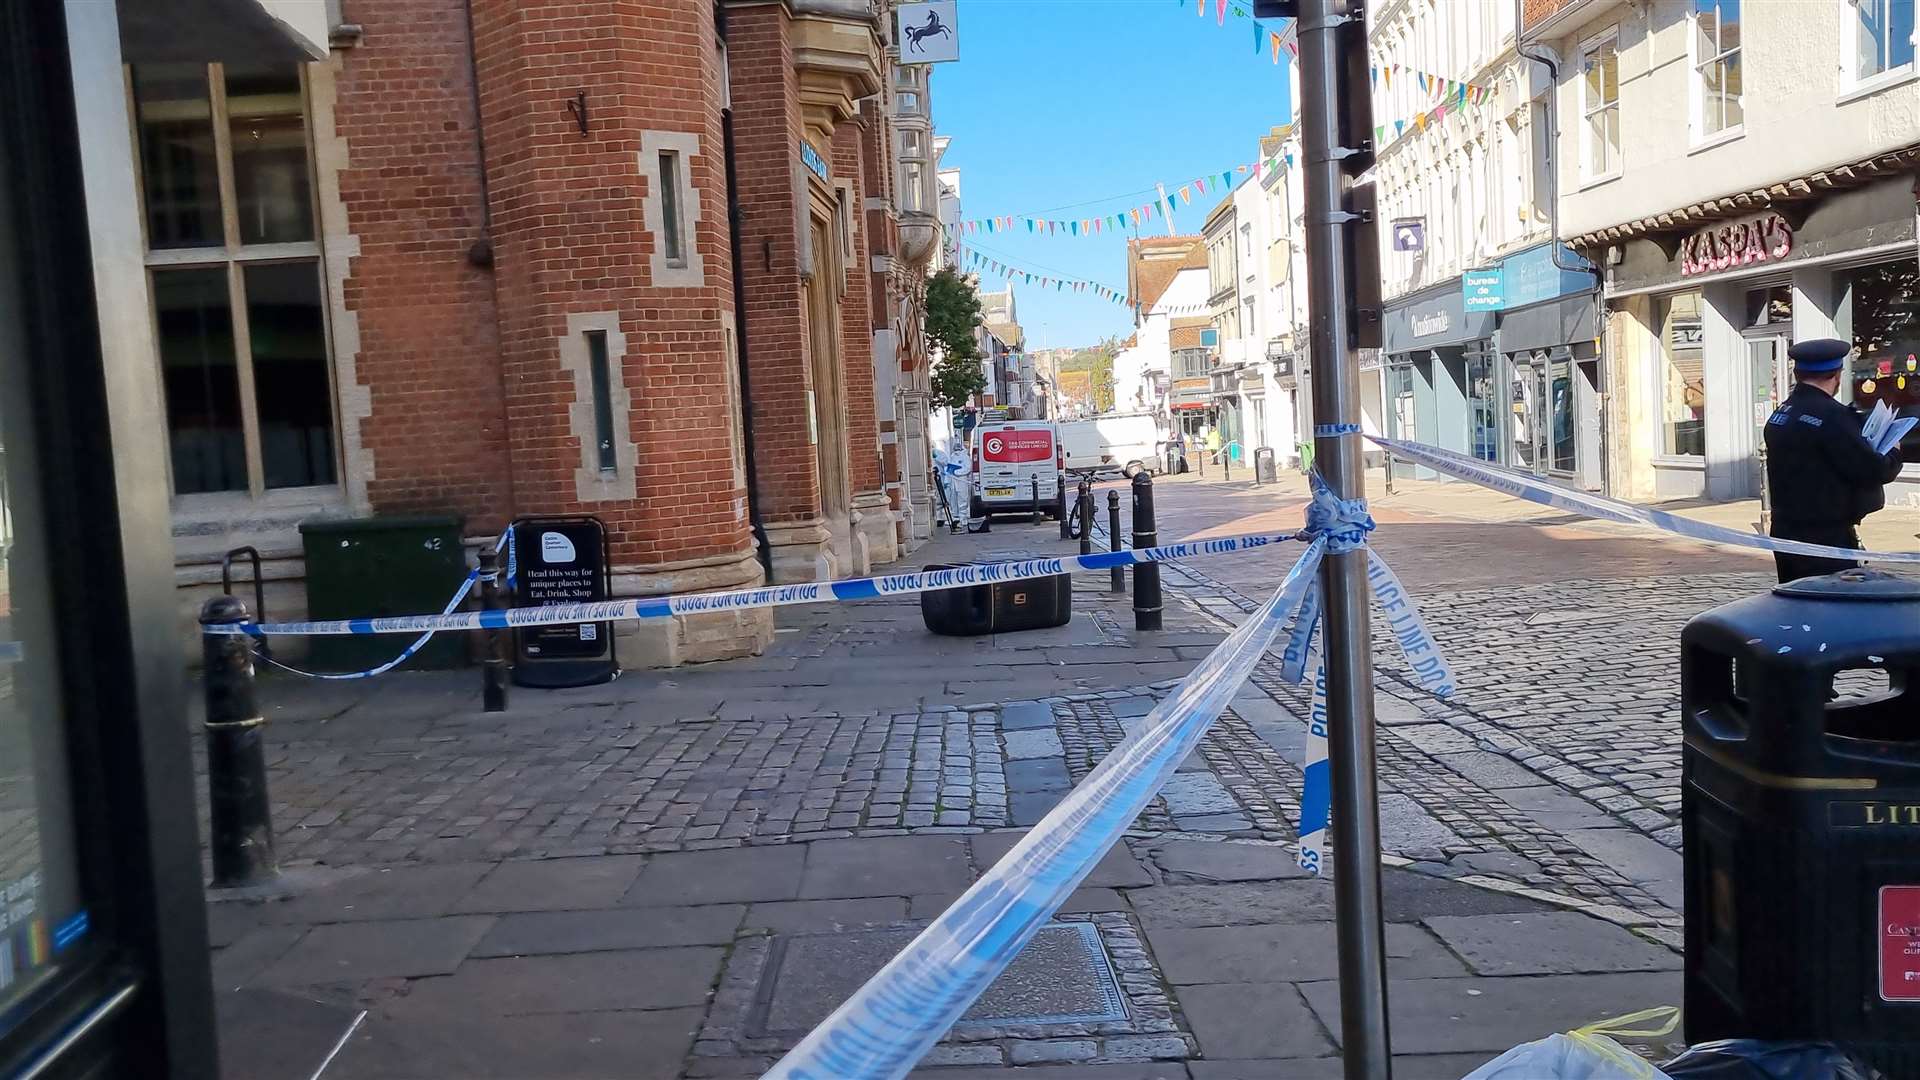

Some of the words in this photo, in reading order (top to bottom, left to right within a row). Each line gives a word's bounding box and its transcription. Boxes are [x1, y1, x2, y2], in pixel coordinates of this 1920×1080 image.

[1680, 213, 1794, 277] KASPA'S
[1467, 277, 1499, 286] bureau
[1477, 287, 1489, 295] de
[1467, 296, 1500, 306] change
[527, 569, 547, 578] Head
[549, 569, 564, 577] this
[564, 570, 579, 578] way
[581, 568, 593, 576] for
[956, 567, 975, 584] DO
[979, 564, 1010, 581] LINE
[1014, 559, 1063, 578] POLICE
[530, 581, 557, 589] unique
[558, 579, 582, 588] places
[882, 574, 923, 592] CROSS
[927, 570, 953, 587] NOT
[531, 590, 546, 599] Eat,
[572, 589, 592, 598] Shop
[735, 592, 750, 606] DO
[753, 589, 777, 604] LINE
[780, 584, 819, 601] POLICE
[675, 597, 709, 612] CROSS
[711, 595, 732, 608] NOT
[510, 609, 538, 624] CROSS
[539, 607, 557, 621] NOT
[593, 602, 627, 617] POLICE
[1284, 593, 1314, 663] POLICE
[1390, 613, 1431, 656] LINE
[1412, 656, 1446, 686] DO
